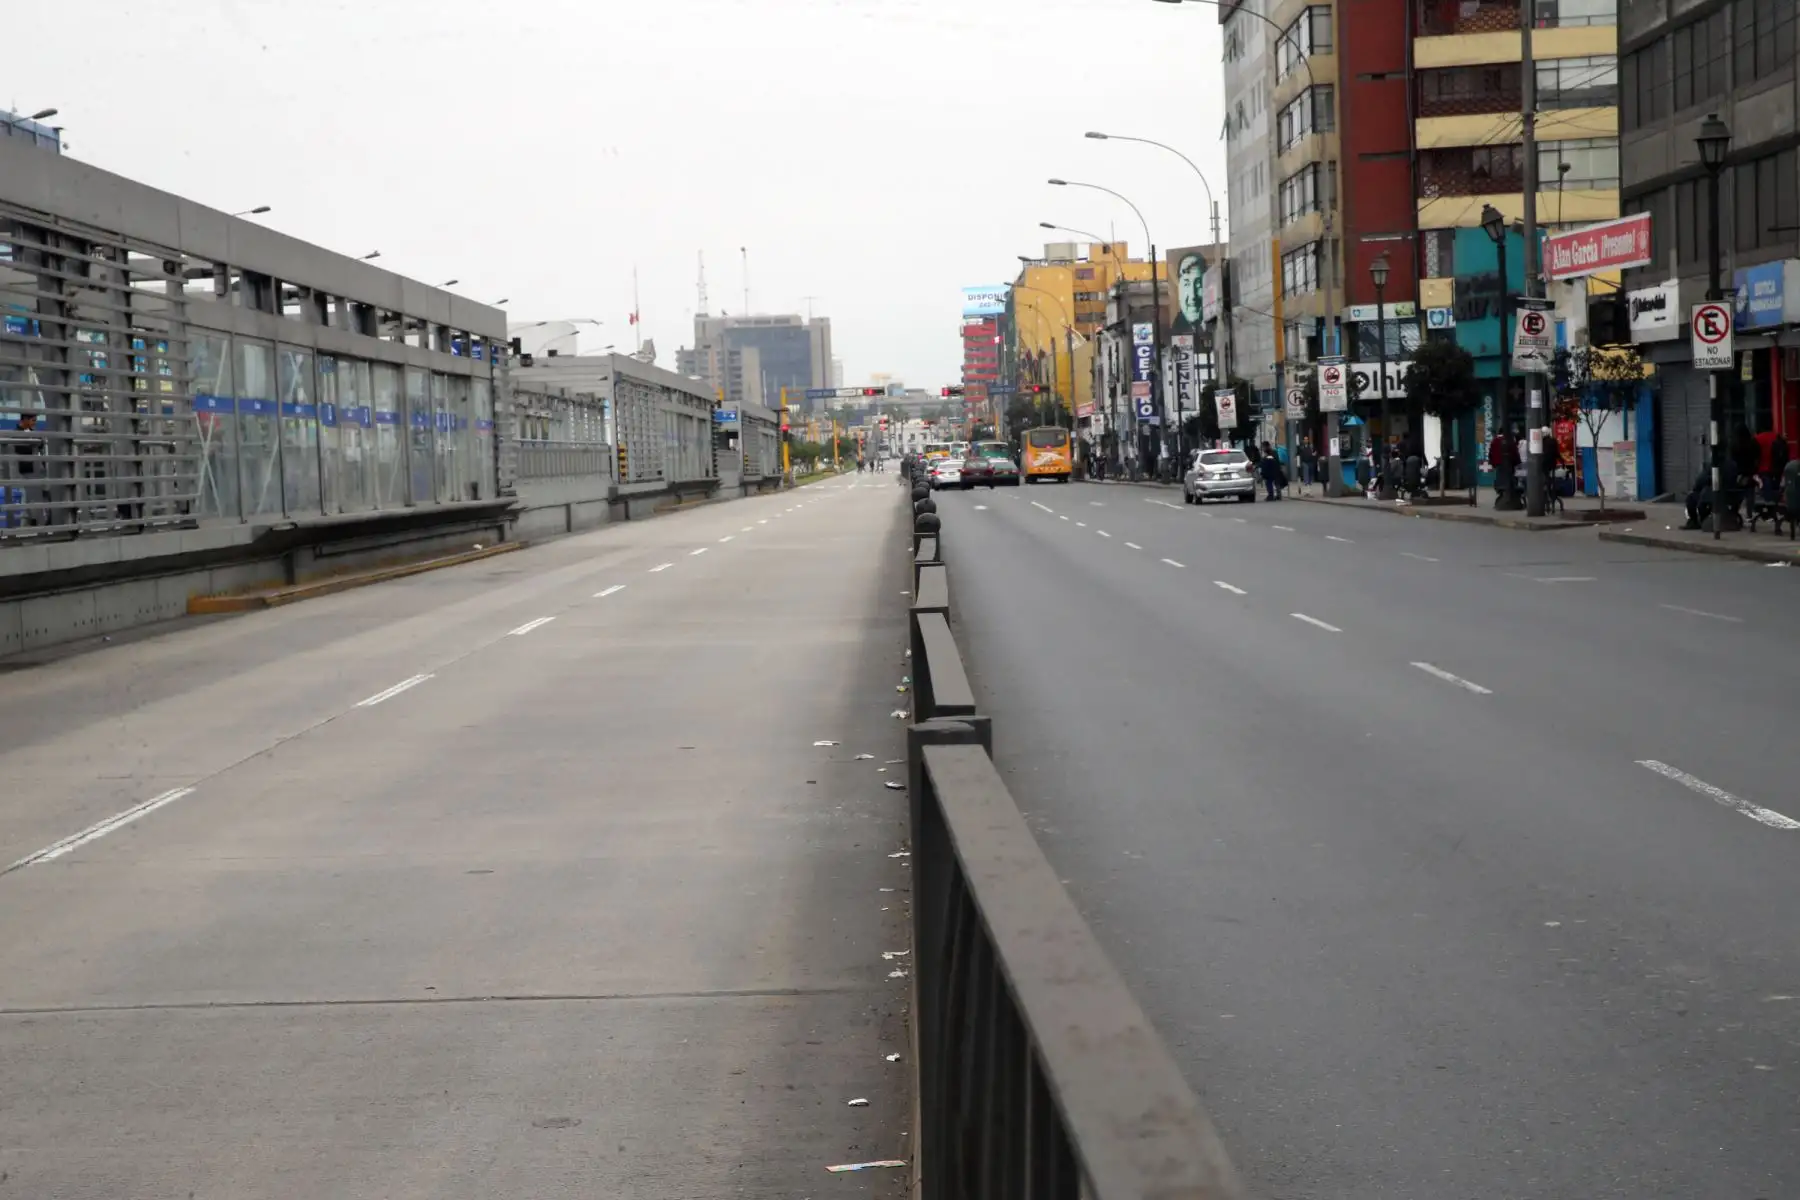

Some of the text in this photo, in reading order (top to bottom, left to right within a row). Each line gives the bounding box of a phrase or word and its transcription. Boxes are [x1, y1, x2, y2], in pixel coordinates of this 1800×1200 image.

[1553, 244, 1571, 270] Alan
[1572, 236, 1598, 265] García
[1707, 346, 1718, 355] NO
[1695, 356, 1731, 367] ESTACIONAR
